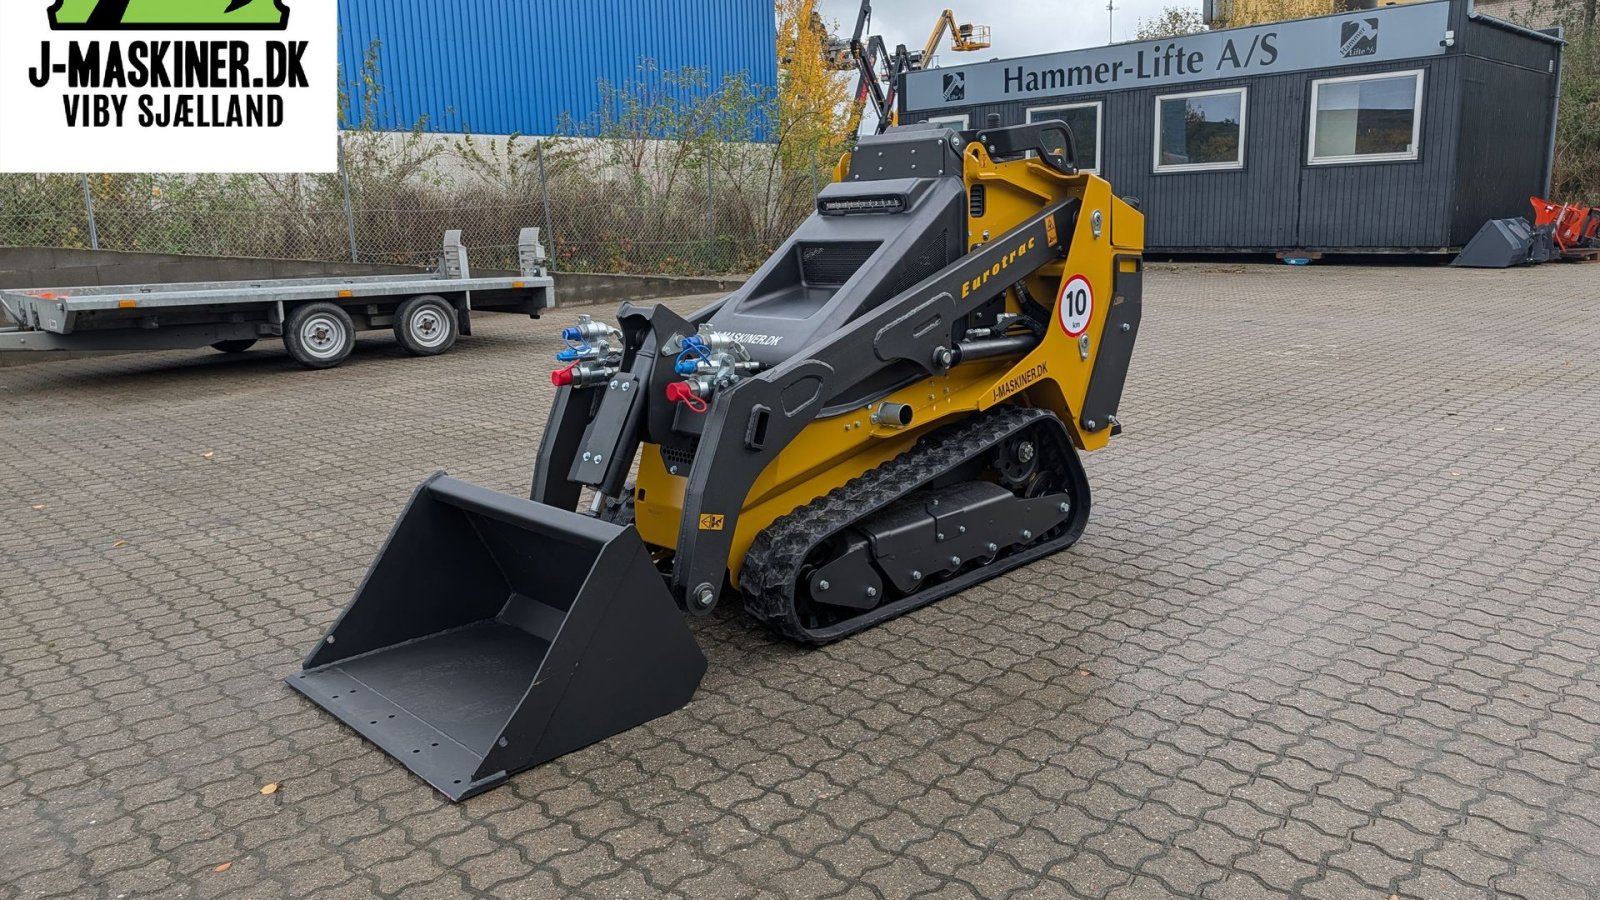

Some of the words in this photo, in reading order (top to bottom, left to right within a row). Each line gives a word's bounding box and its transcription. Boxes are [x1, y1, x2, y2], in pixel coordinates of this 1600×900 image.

[1340, 28, 1365, 55] Hammer
[1004, 43, 1204, 93] Hammer-Lifte
[1216, 32, 1279, 71] A/S
[961, 236, 1035, 299] Eurotrac
[1066, 288, 1087, 318] 10
[1072, 321, 1081, 329] km
[993, 361, 1048, 402] J-MASKINER.DK
